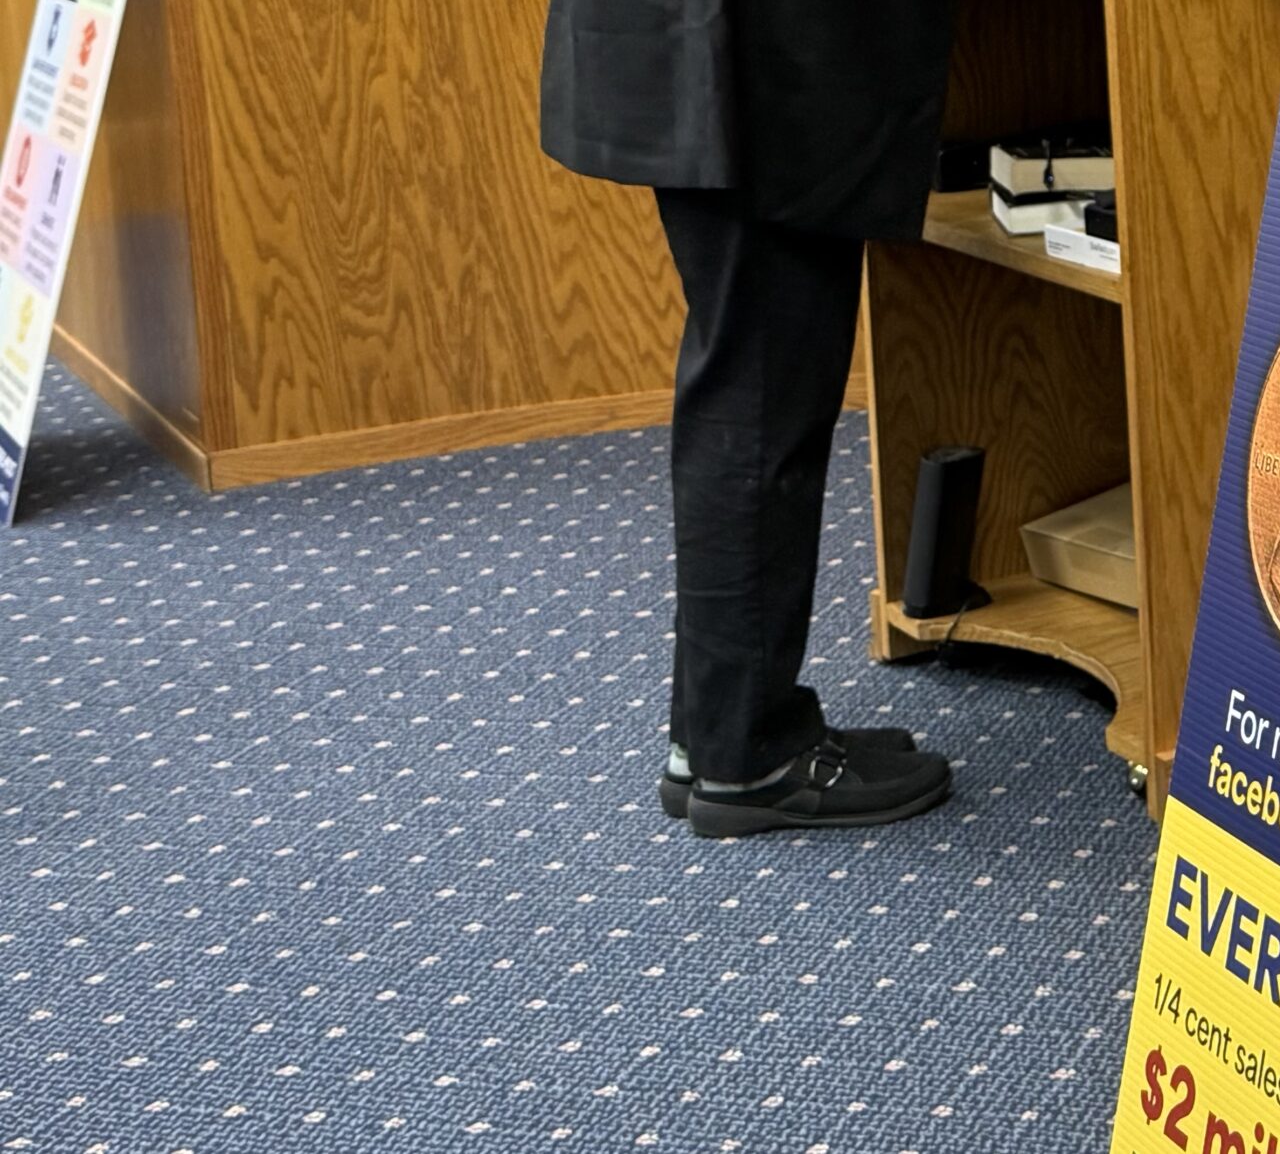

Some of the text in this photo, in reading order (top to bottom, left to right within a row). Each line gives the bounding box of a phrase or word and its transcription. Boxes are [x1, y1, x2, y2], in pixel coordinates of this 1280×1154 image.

[1225, 689, 1270, 750] For
[1154, 973, 1182, 1024] 1/4
[1185, 1007, 1232, 1065] cent
[1141, 1045, 1196, 1152] $2
